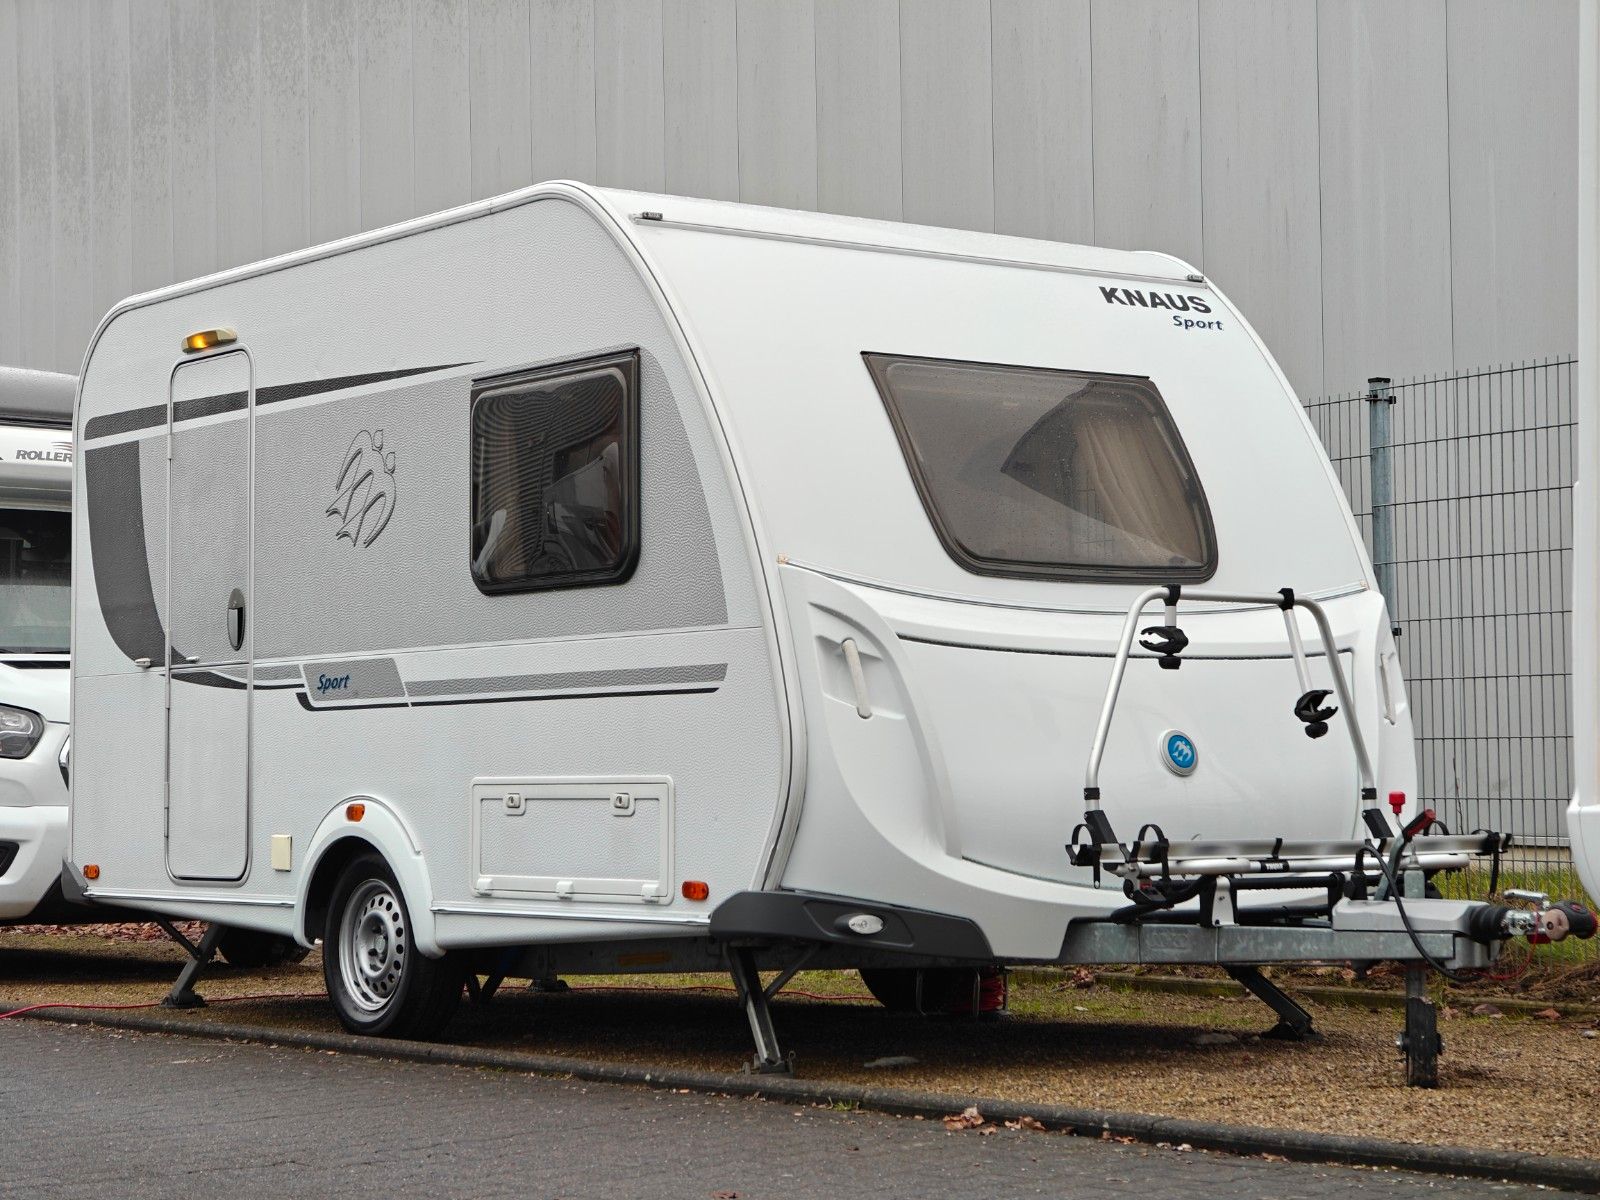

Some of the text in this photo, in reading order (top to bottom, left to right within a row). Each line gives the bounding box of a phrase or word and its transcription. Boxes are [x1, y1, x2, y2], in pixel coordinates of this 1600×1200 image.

[1099, 286, 1212, 314] KNAUS
[1172, 315, 1224, 330] Sport
[15, 449, 73, 463] ROLLER
[317, 674, 350, 694] Sport
